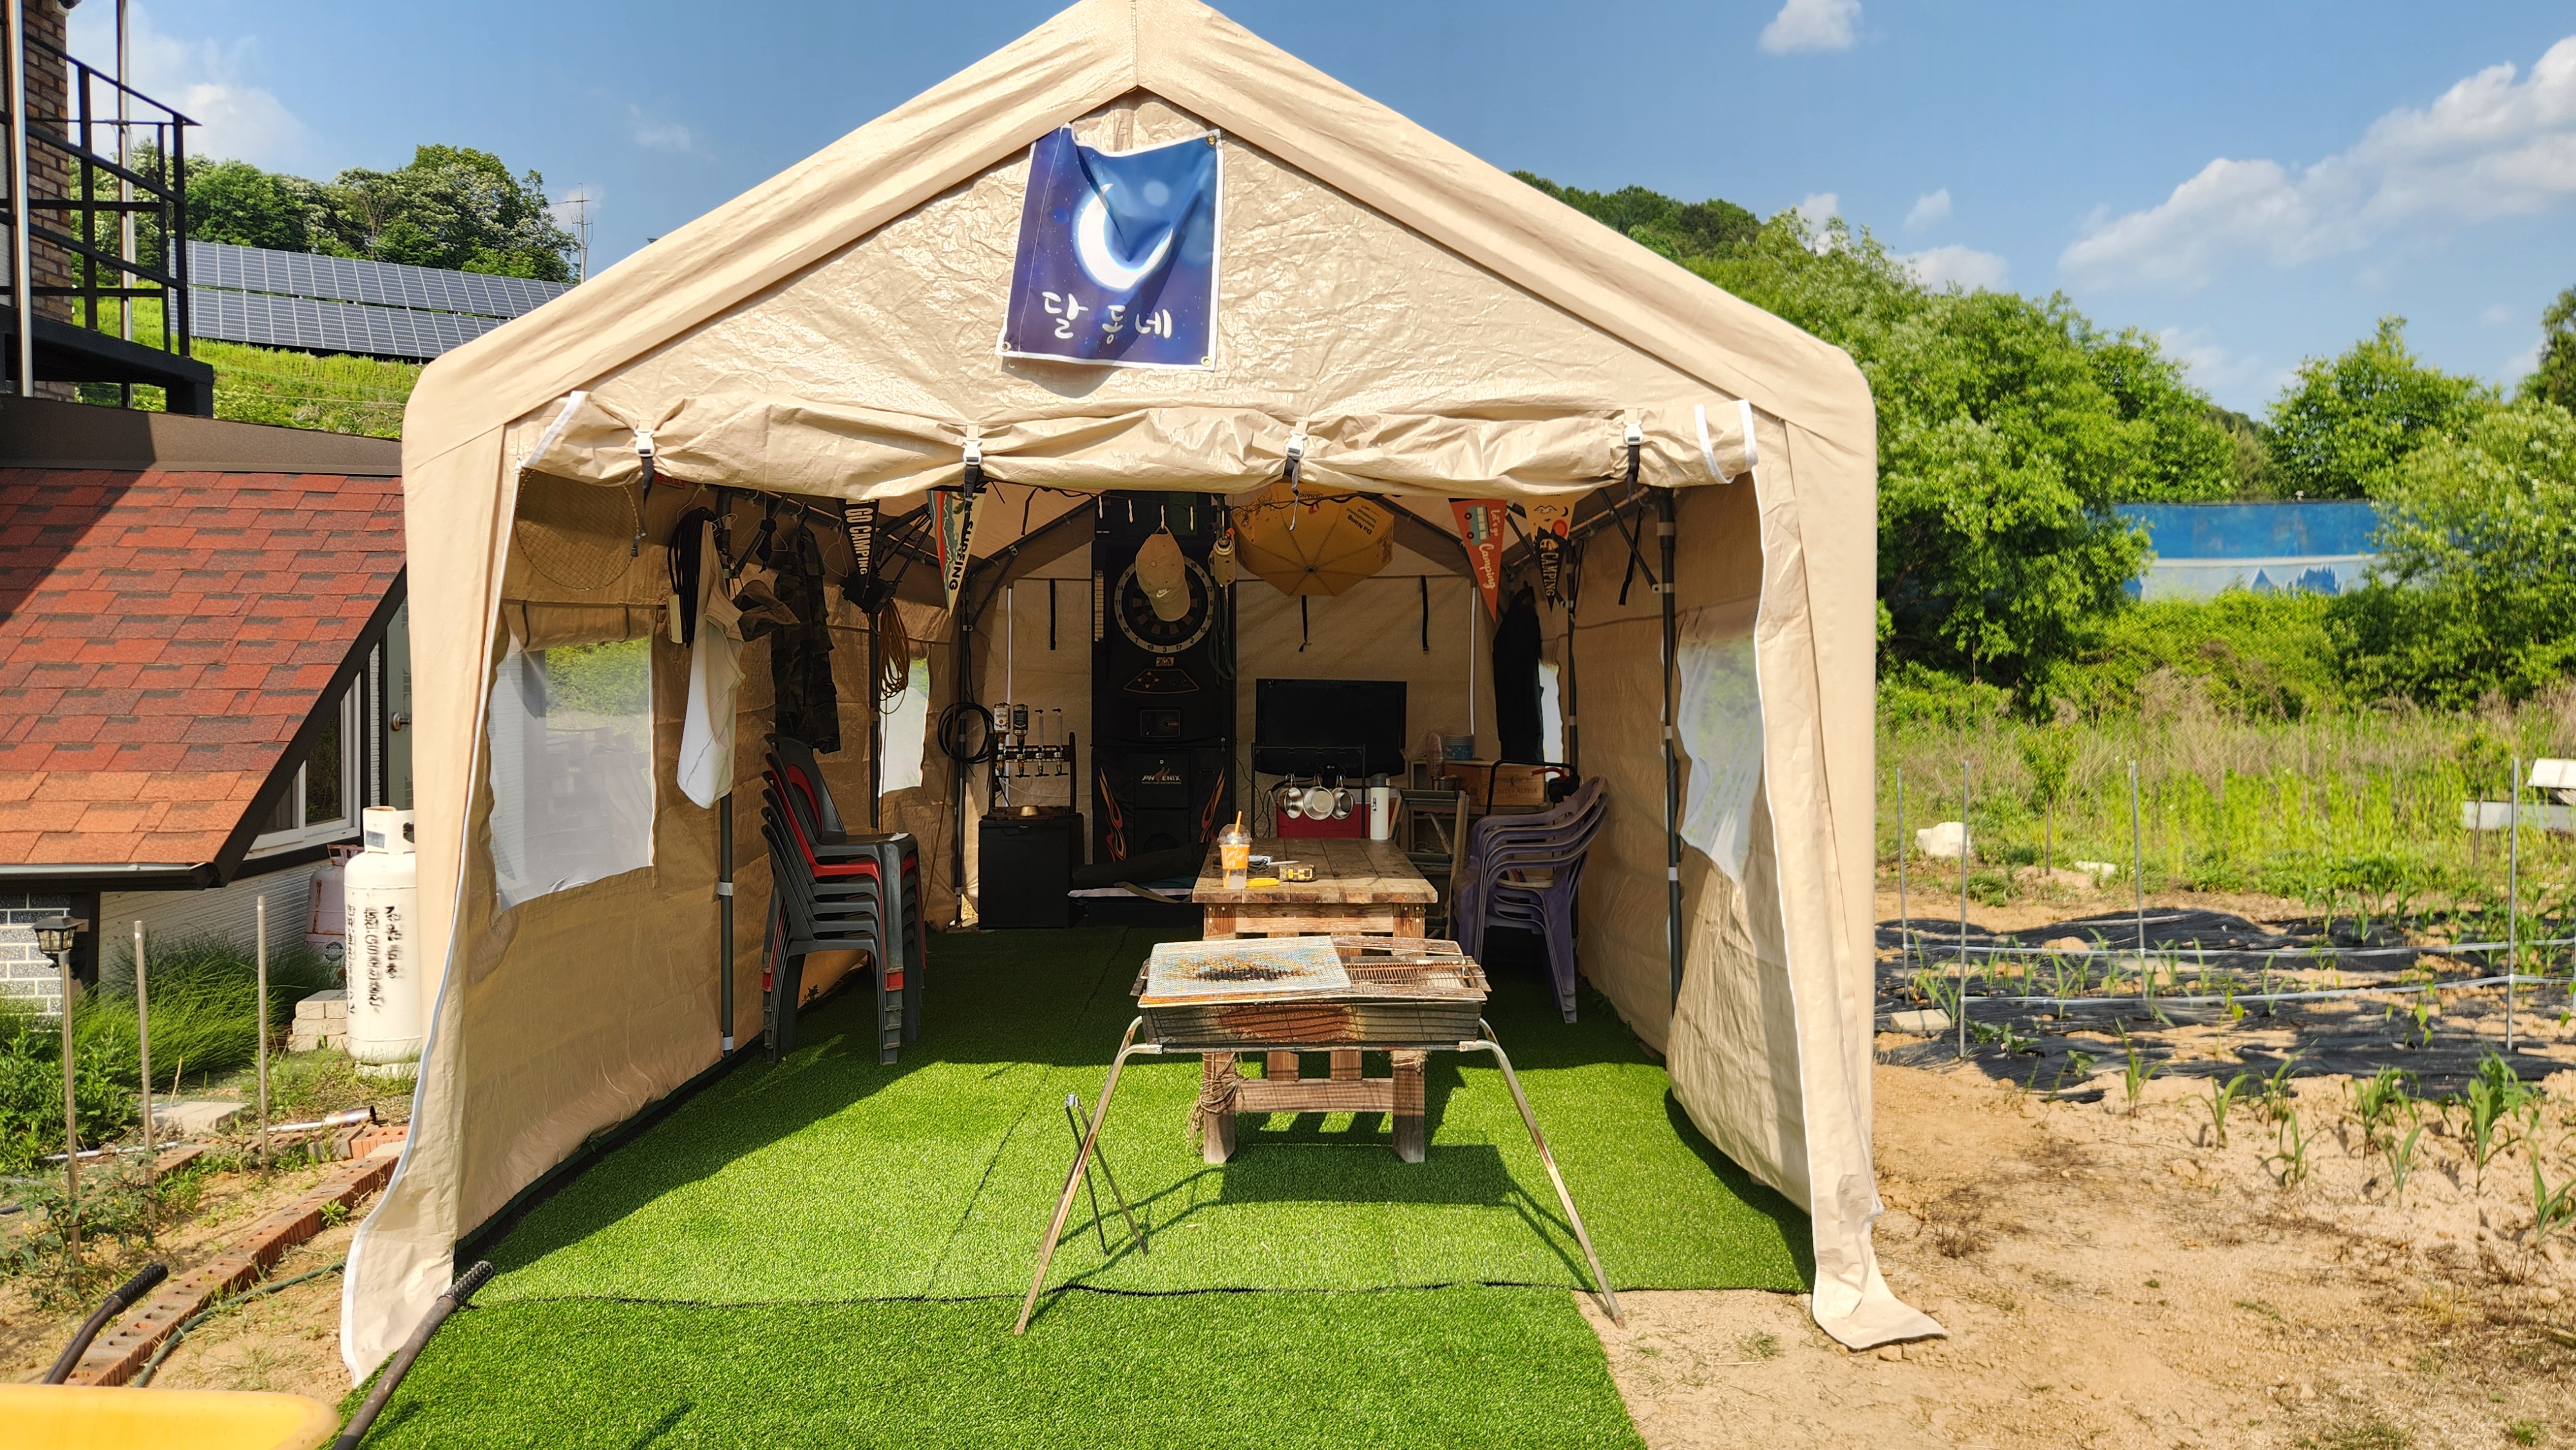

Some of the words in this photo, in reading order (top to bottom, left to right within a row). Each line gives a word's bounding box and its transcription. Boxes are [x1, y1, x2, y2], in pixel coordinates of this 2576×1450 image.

[1042, 292, 1172, 344] 달동네
[844, 507, 873, 523] GO
[1490, 528, 1499, 537] go
[849, 525, 872, 576] CAMPING
[1479, 543, 1495, 590] Camping
[1540, 552, 1559, 596] CAMPING
